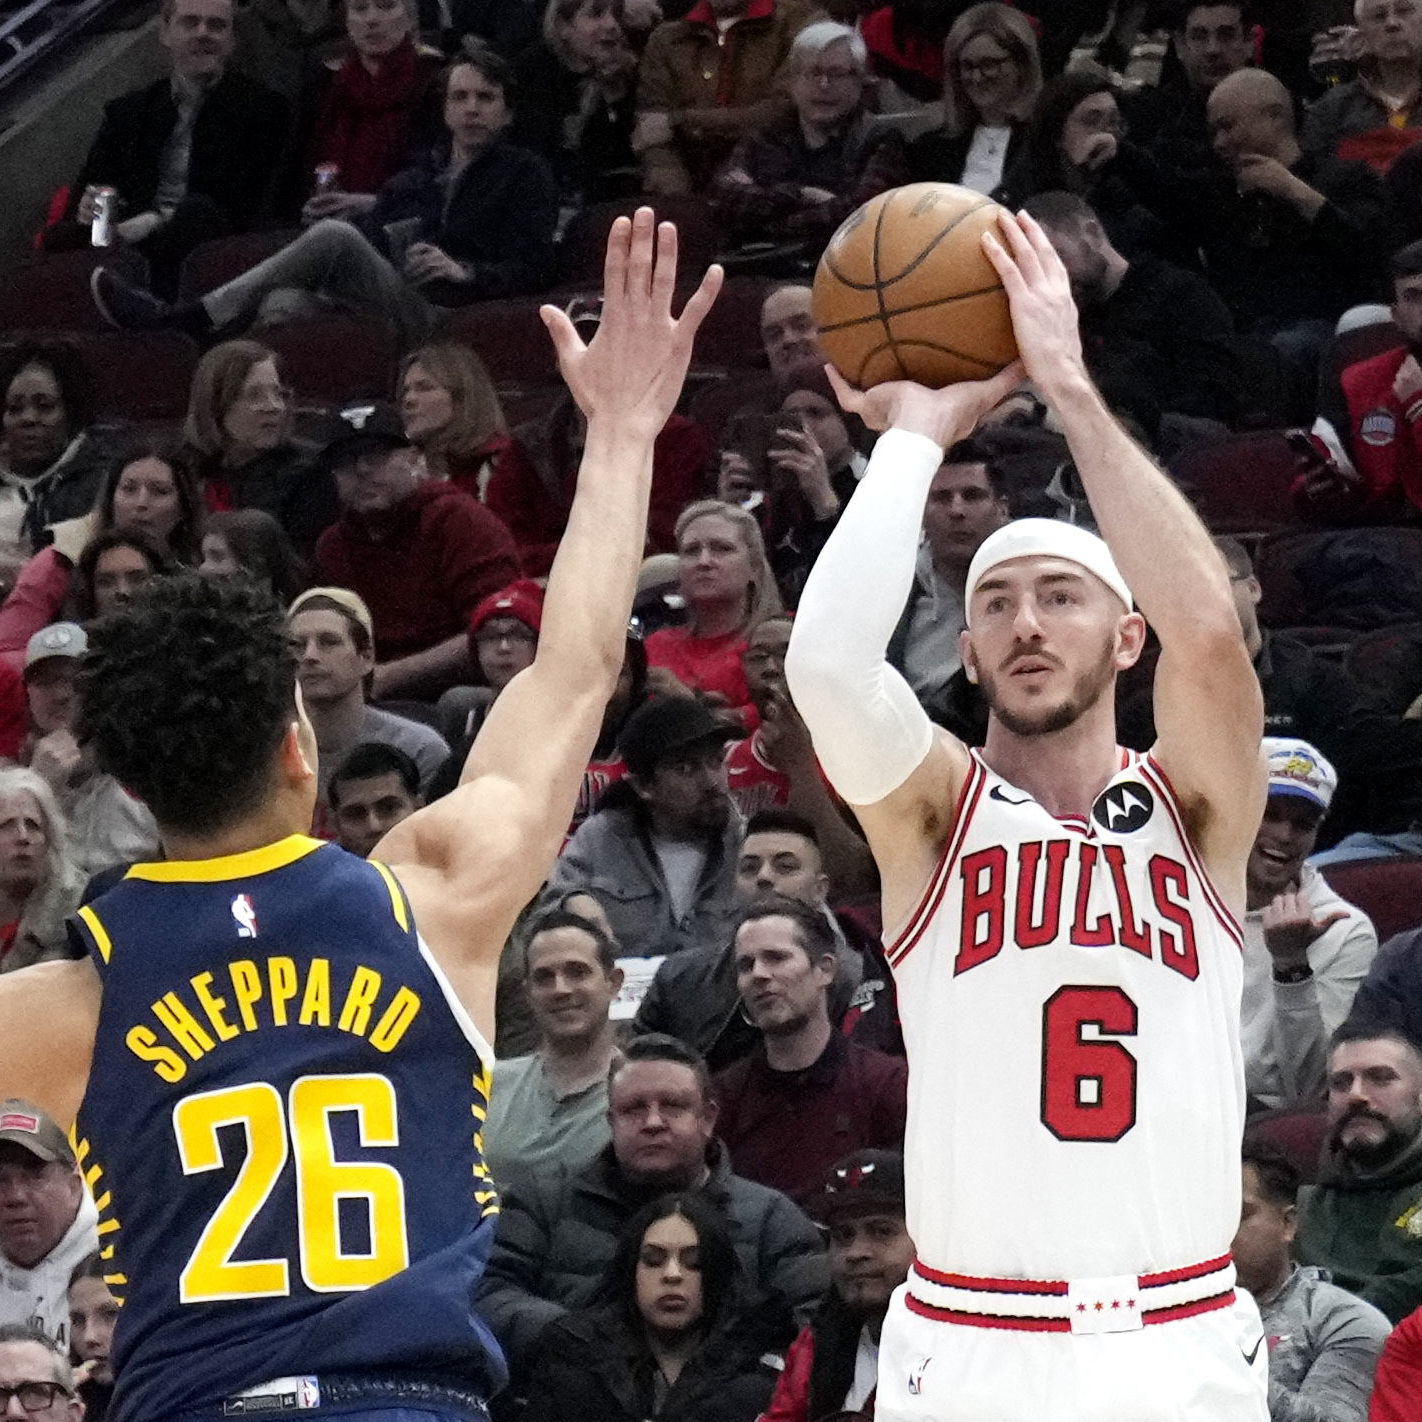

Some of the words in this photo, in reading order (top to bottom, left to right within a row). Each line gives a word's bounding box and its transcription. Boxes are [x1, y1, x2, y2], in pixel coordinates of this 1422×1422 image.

[953, 838, 1200, 982] BULLS
[125, 955, 423, 1084] SHEPPARD
[1040, 984, 1138, 1143] 6
[172, 1072, 409, 1304] 26
